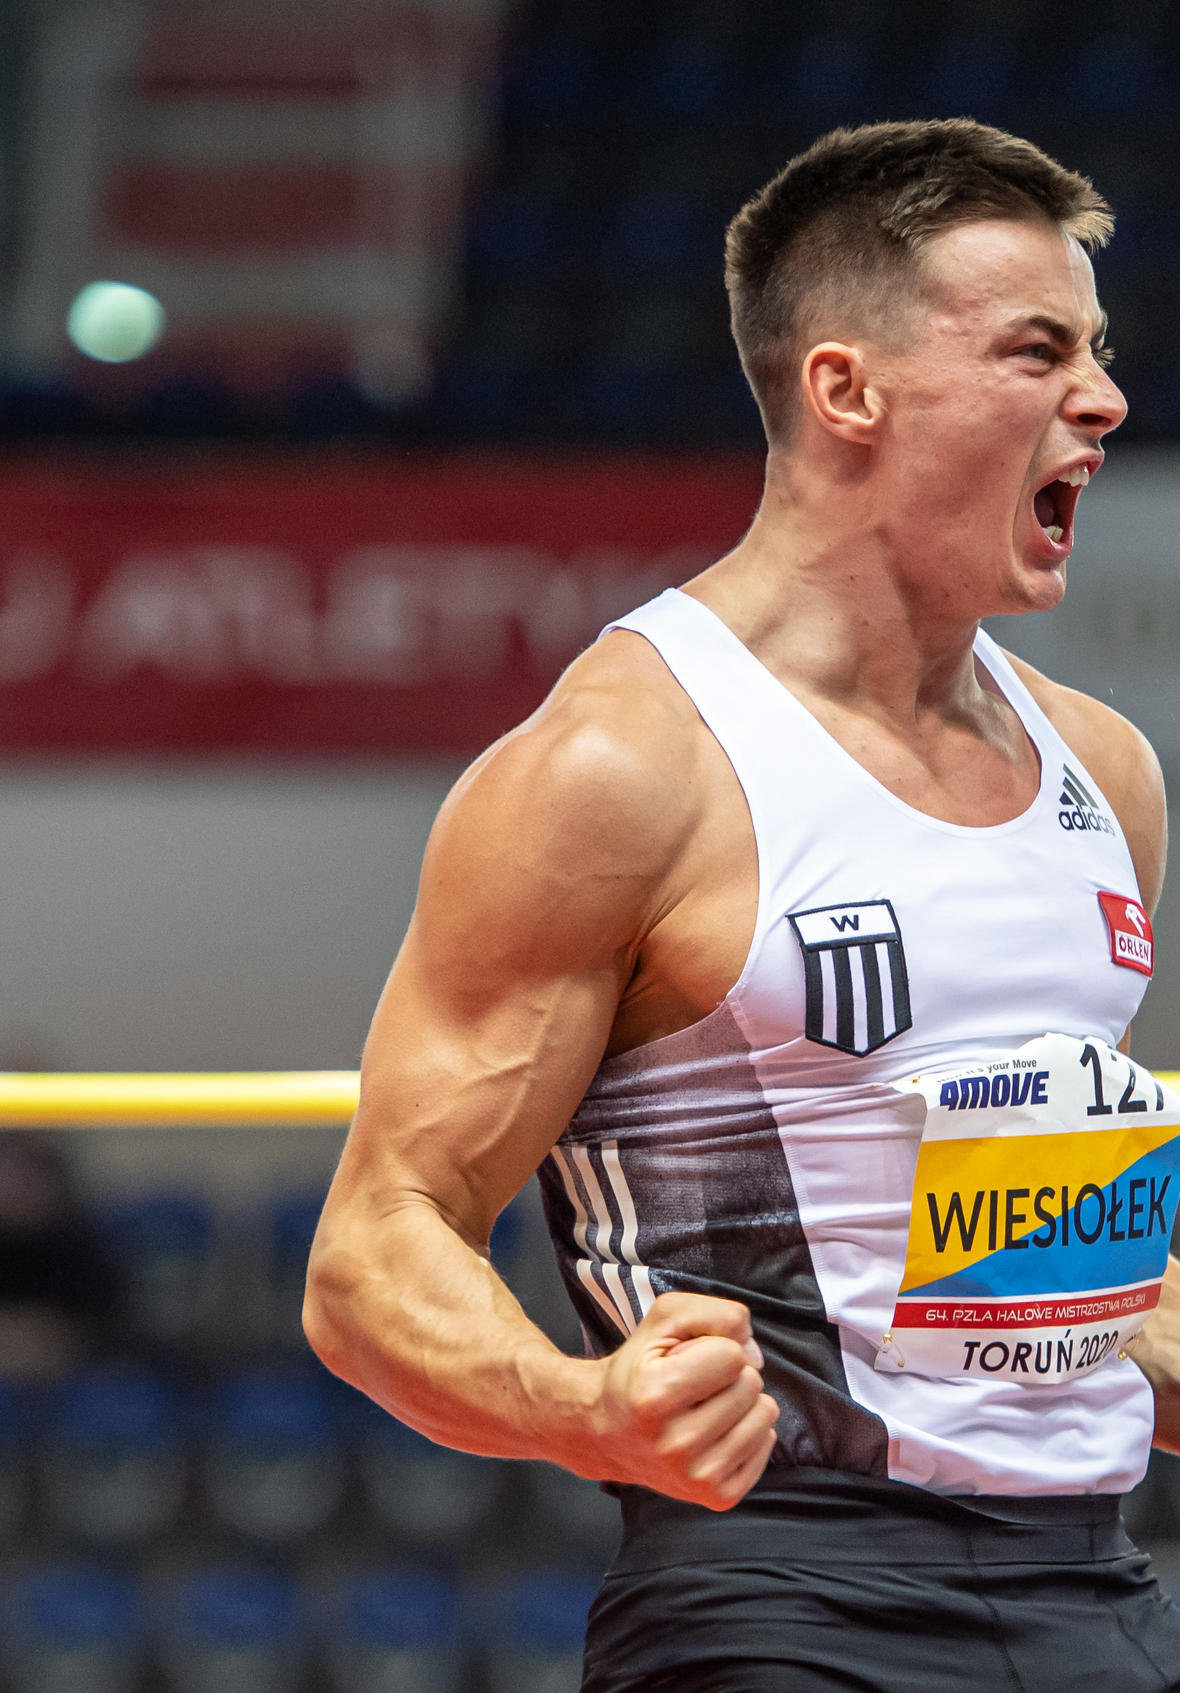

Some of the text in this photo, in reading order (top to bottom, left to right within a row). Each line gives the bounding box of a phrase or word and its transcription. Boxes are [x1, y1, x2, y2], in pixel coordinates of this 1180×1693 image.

[1058, 805, 1116, 837] adidas
[829, 914, 860, 932] W
[1118, 936, 1150, 962] ORLEN
[986, 1059, 1038, 1074] your Move
[939, 1071, 1050, 1111] 4MOVE
[926, 1174, 1173, 1253] WIESIOŁEK
[925, 1292, 1147, 1322] 64. PZLA HALOWE MISTRZOSTWA POLSKI
[962, 1329, 1119, 1374] TORUŃ 2020
